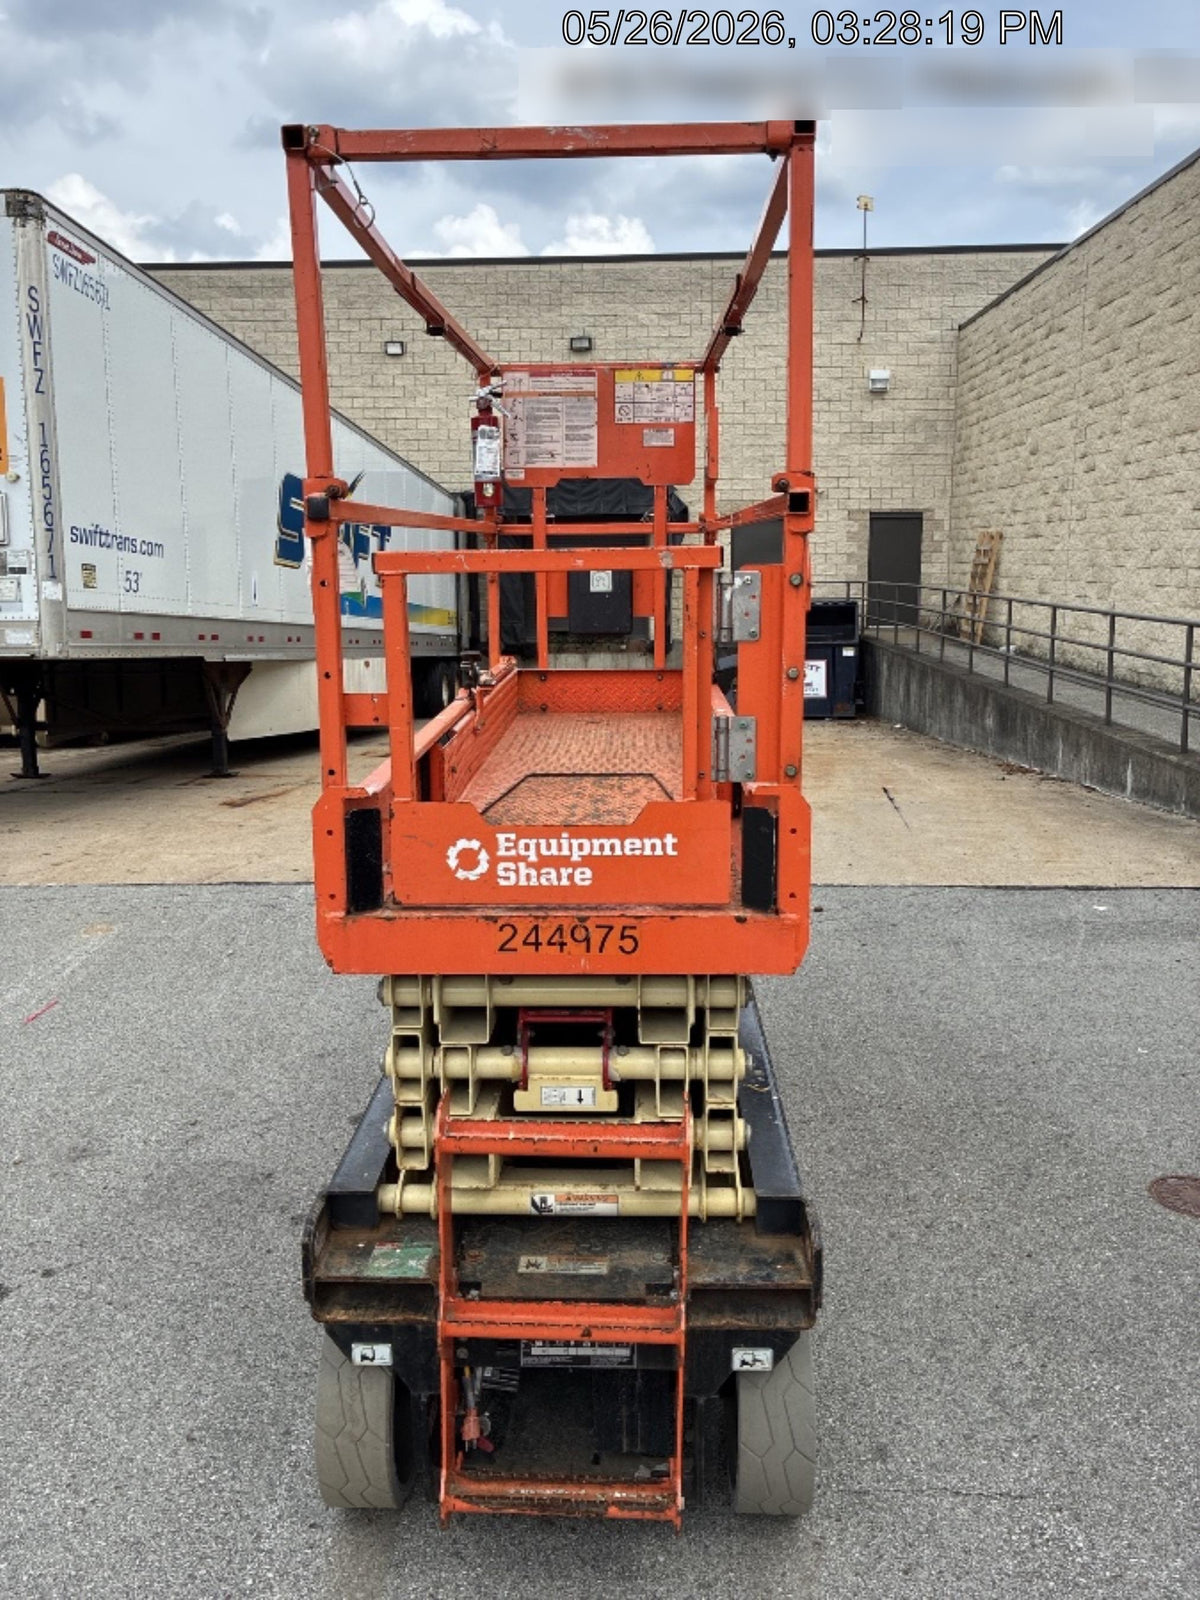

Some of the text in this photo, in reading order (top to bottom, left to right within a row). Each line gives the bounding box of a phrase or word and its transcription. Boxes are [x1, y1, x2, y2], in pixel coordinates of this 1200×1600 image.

[70, 524, 165, 559] swifttrans.com
[496, 831, 678, 861] Equipment
[496, 862, 593, 886] Share
[497, 923, 640, 955] 244975
